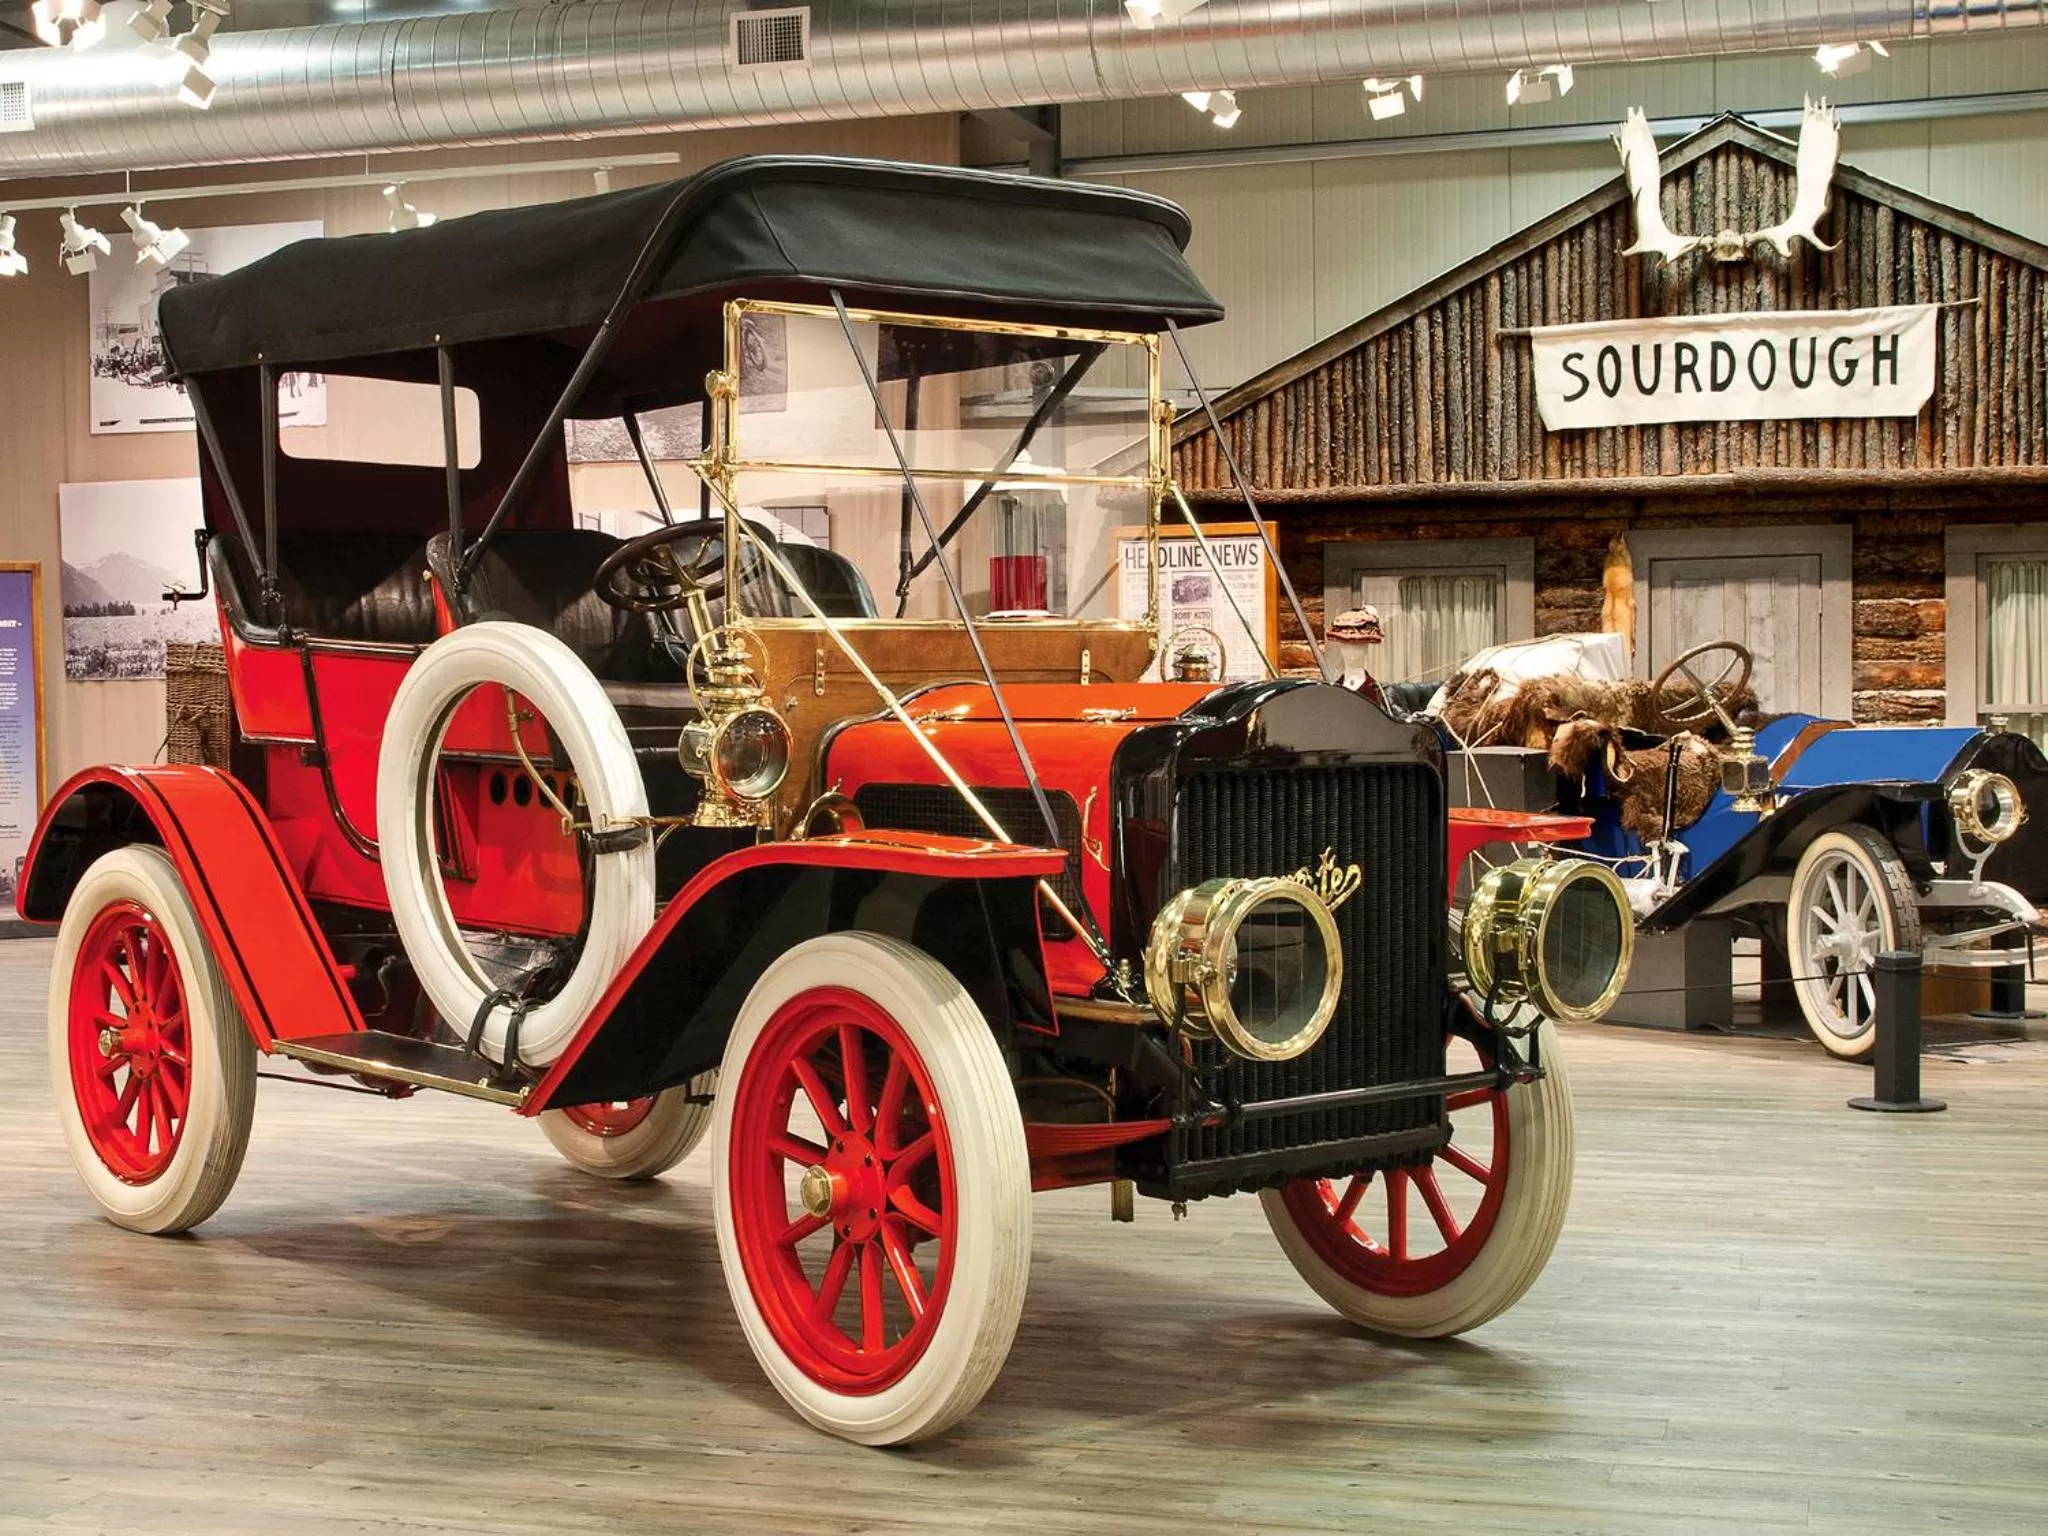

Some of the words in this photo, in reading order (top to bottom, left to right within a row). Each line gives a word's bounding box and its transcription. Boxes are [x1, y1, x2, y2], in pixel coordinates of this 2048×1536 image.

[1562, 334, 1899, 402] SOURDOUGH
[1125, 545, 1202, 569] HEDLINE
[1211, 543, 1259, 567] NEWS
